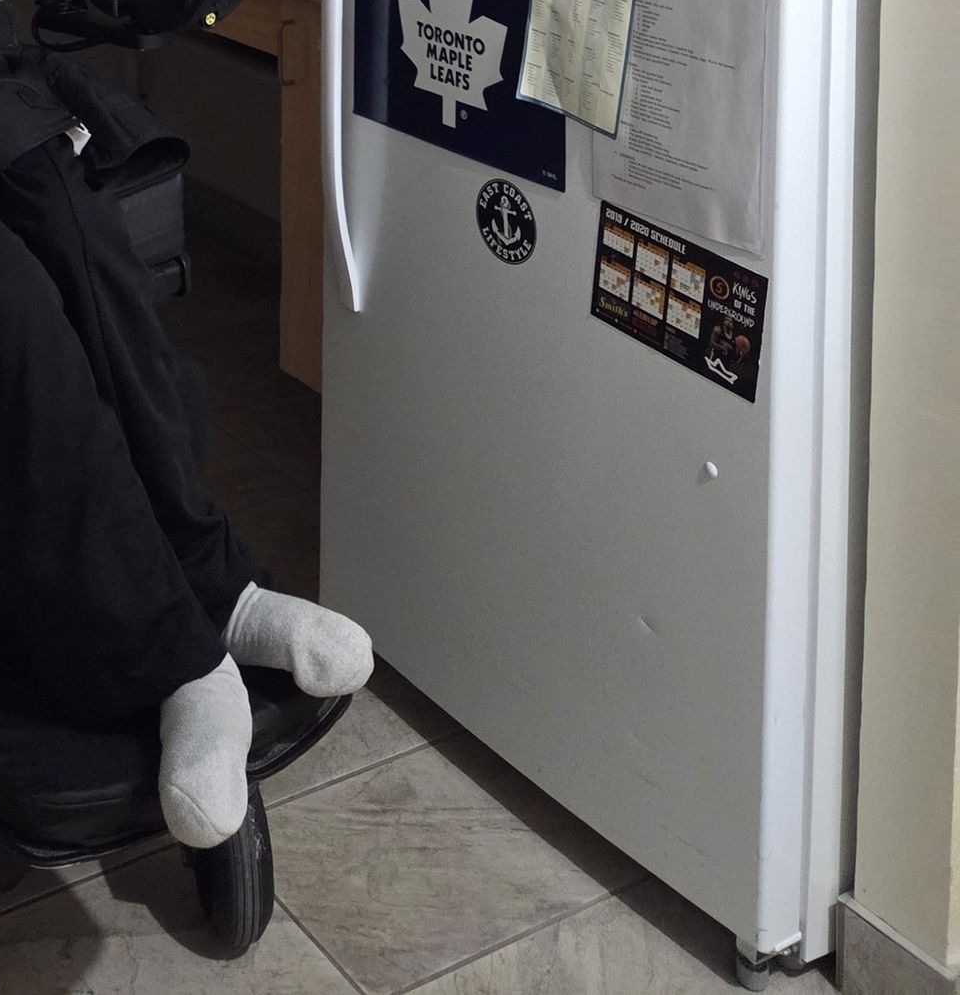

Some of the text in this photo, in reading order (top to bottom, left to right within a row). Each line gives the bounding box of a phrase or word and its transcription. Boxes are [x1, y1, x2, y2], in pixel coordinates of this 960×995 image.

[417, 21, 485, 55] TORONTO
[426, 43, 472, 71] MAPLE
[430, 63, 470, 90] LEAFS
[480, 183, 532, 221] EAST COAST
[482, 226, 532, 261] LIFESTYLE
[630, 220, 650, 237] 2020
[651, 229, 688, 255] SCHEDULE
[732, 281, 757, 304] KINGS
[733, 299, 756, 316] OF THE
[707, 298, 755, 328] UNDERGROUND
